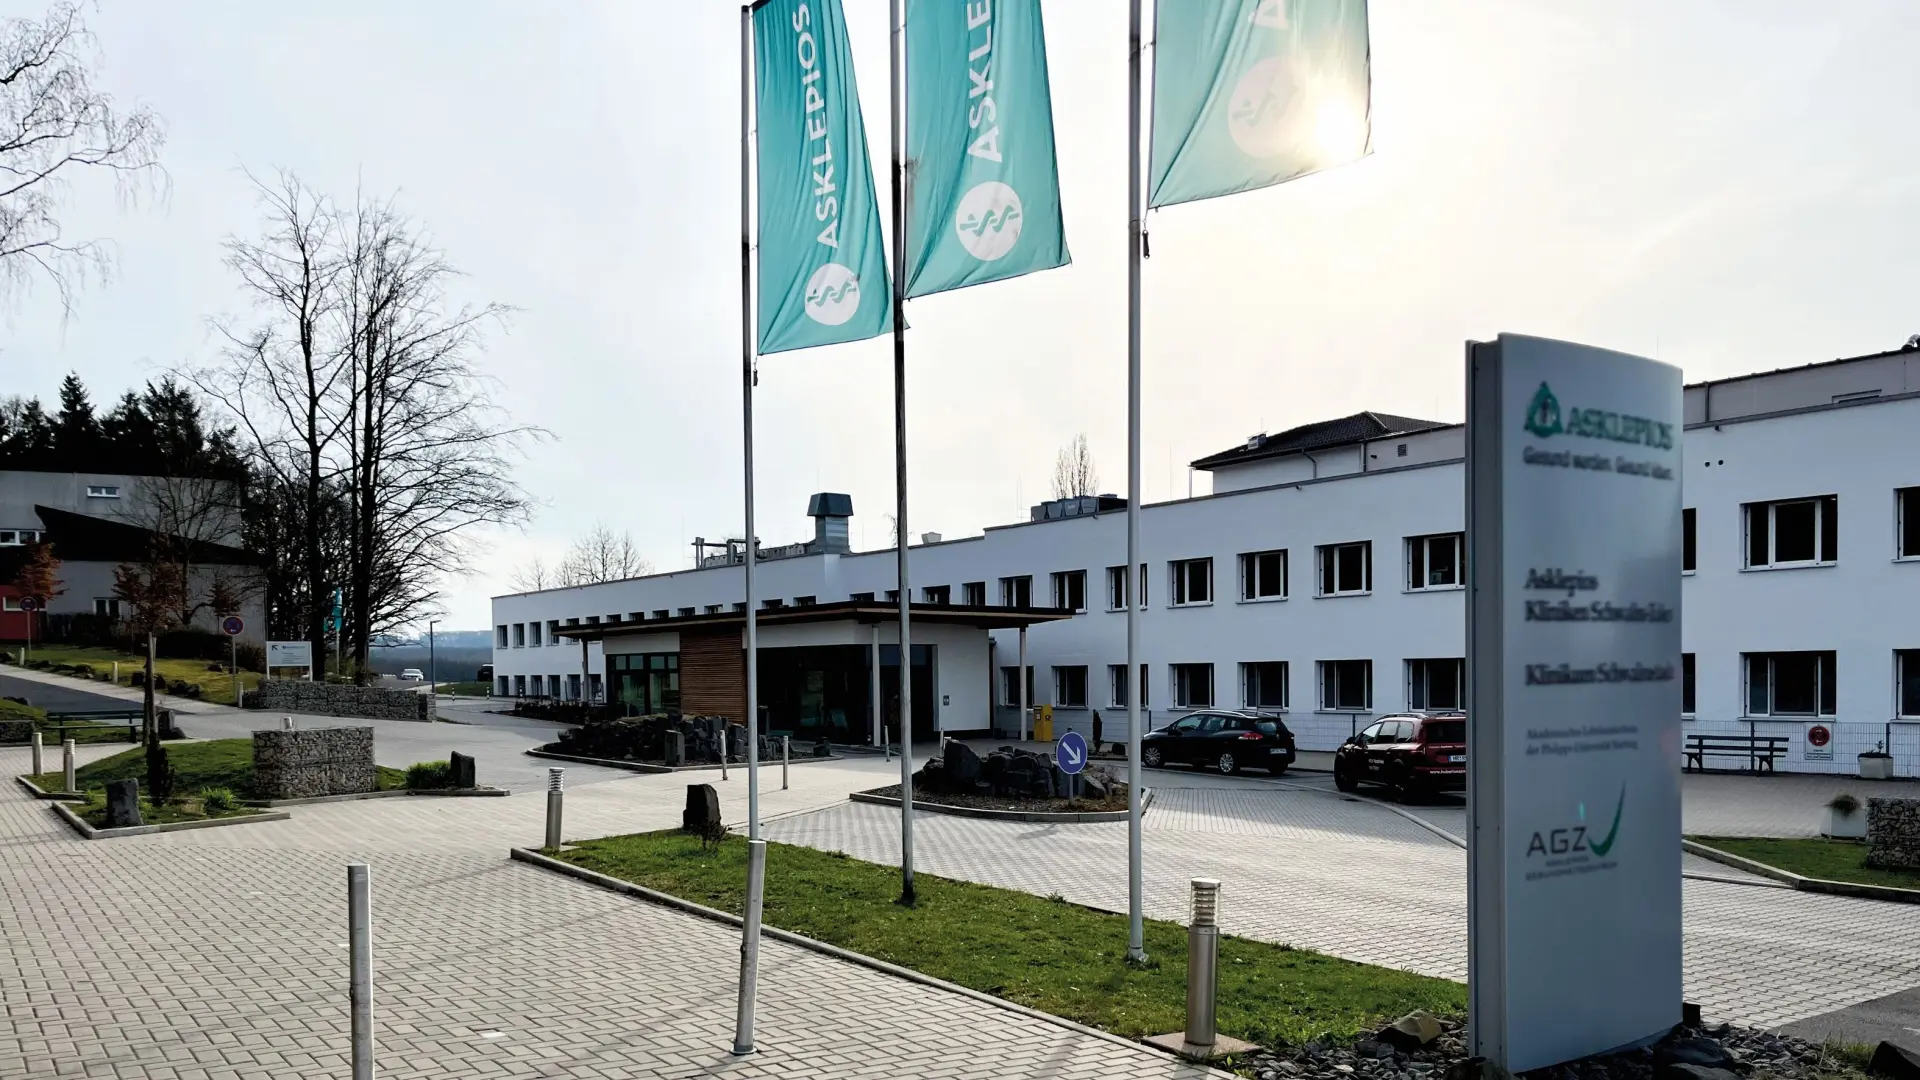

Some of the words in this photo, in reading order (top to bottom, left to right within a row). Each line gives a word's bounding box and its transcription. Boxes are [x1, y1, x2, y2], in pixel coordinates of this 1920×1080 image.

[792, 4, 838, 249] ASKLEPIOS
[1566, 407, 1673, 451] ASKLEPIOS
[1526, 826, 1587, 858] AGZ
